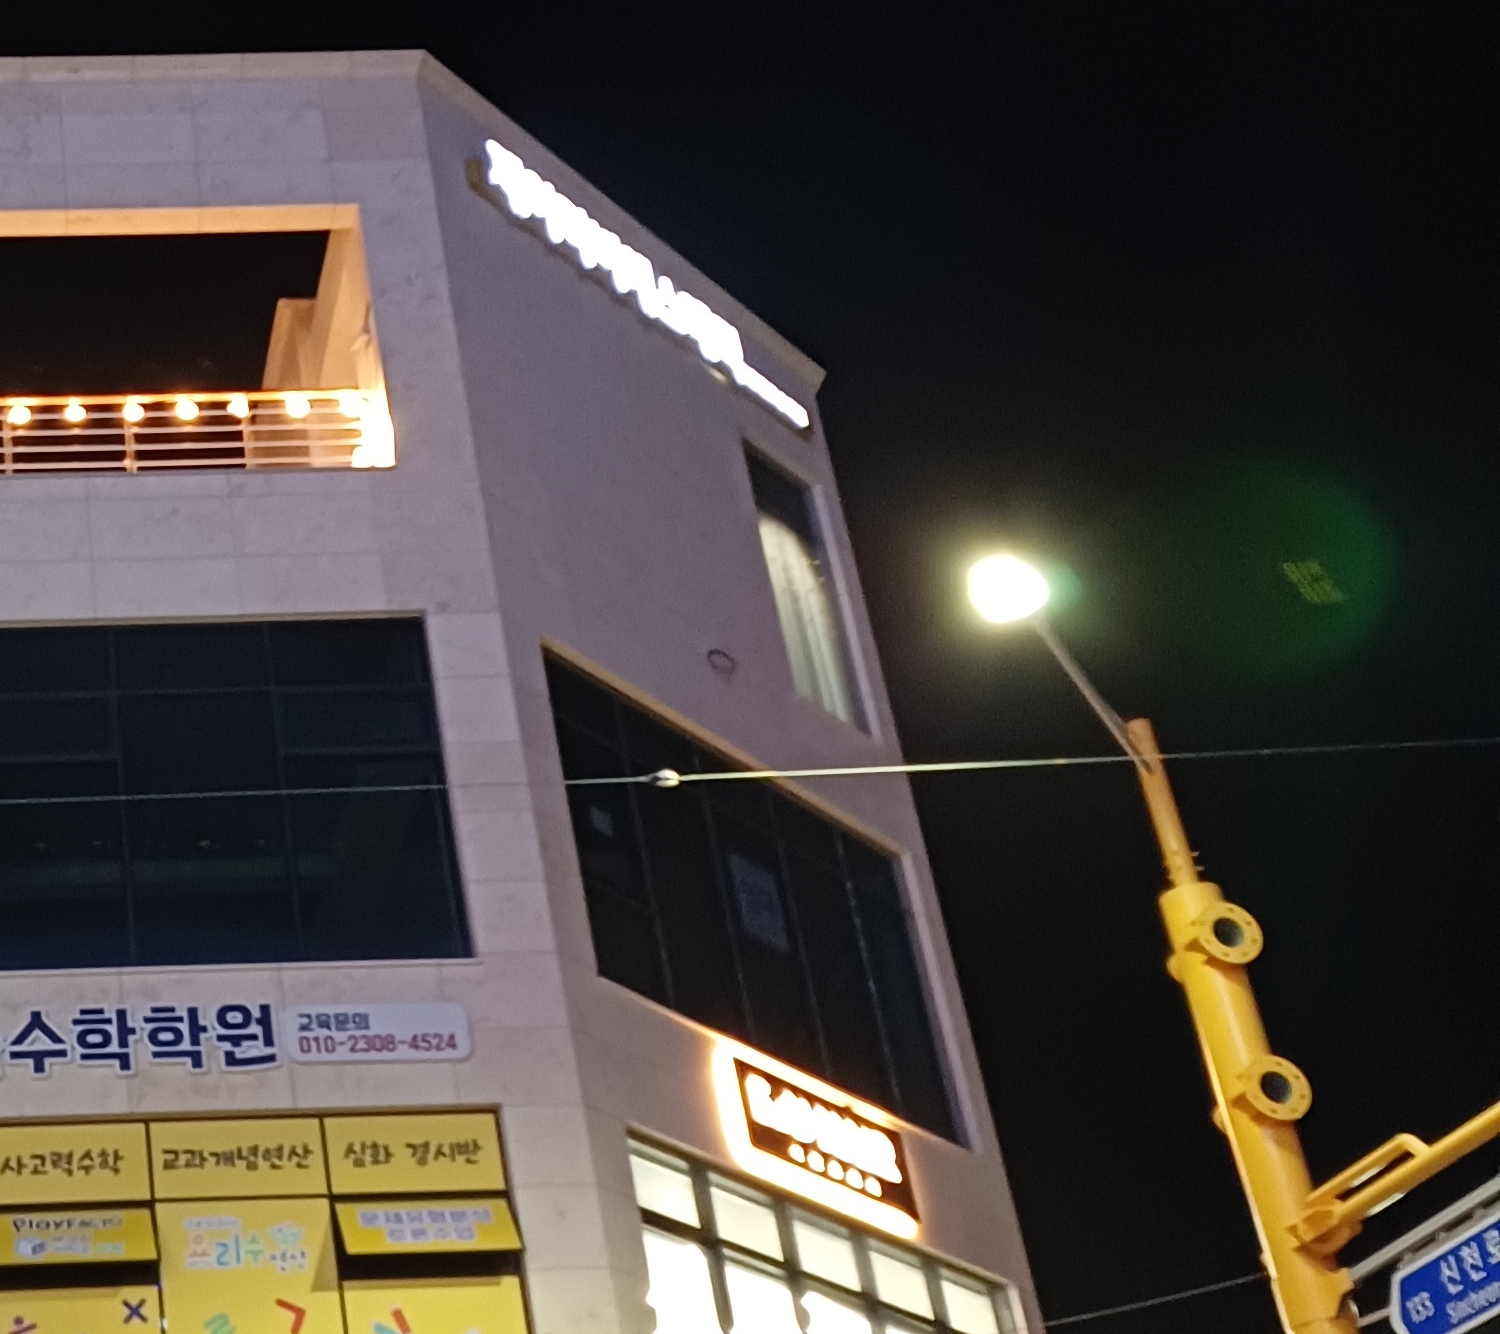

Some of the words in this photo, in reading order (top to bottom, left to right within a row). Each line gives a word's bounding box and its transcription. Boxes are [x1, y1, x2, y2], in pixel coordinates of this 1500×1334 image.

[298, 1032, 458, 1054] 010-2308-4524
[0, 1147, 124, 1178] 사고력수학
[162, 1142, 314, 1171] 교과개념연산
[343, 1140, 394, 1168] 심화
[405, 1138, 484, 1167] 경시반
